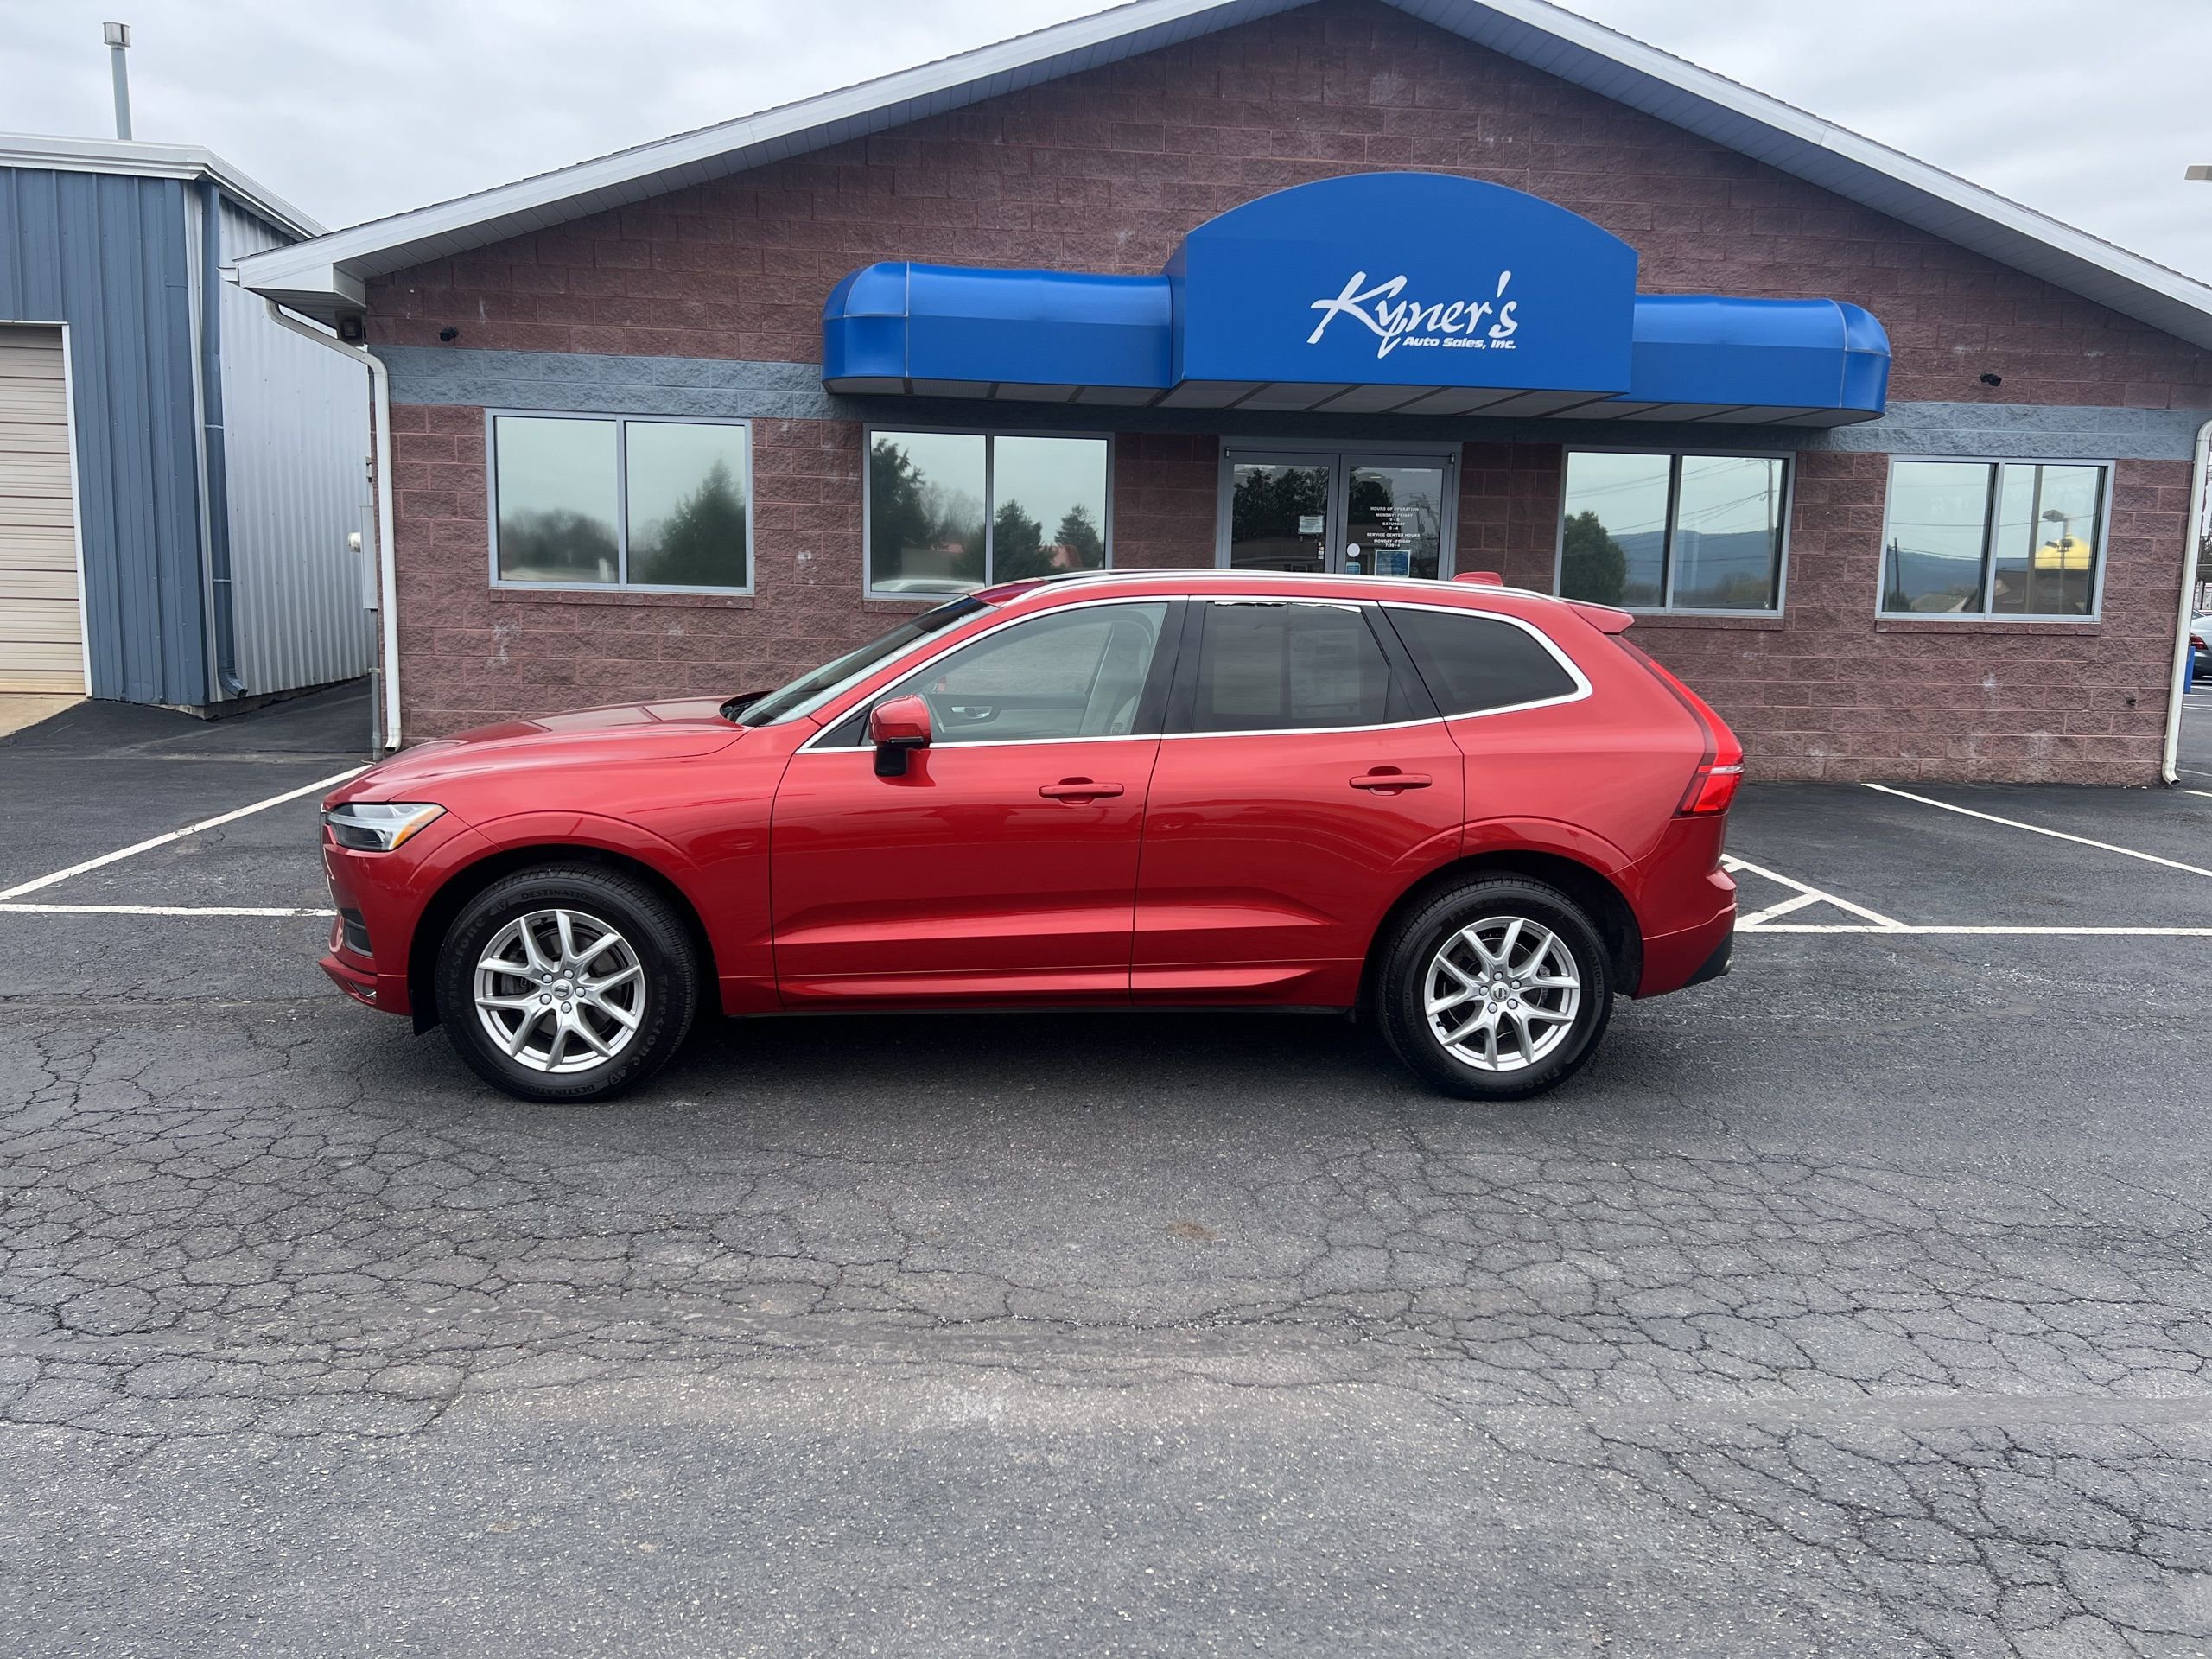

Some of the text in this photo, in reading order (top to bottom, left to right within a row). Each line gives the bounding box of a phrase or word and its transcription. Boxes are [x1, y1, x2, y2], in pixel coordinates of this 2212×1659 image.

[1306, 270, 1518, 359] Kyner's
[1403, 336, 1516, 350] Auto Sales, Inc.
